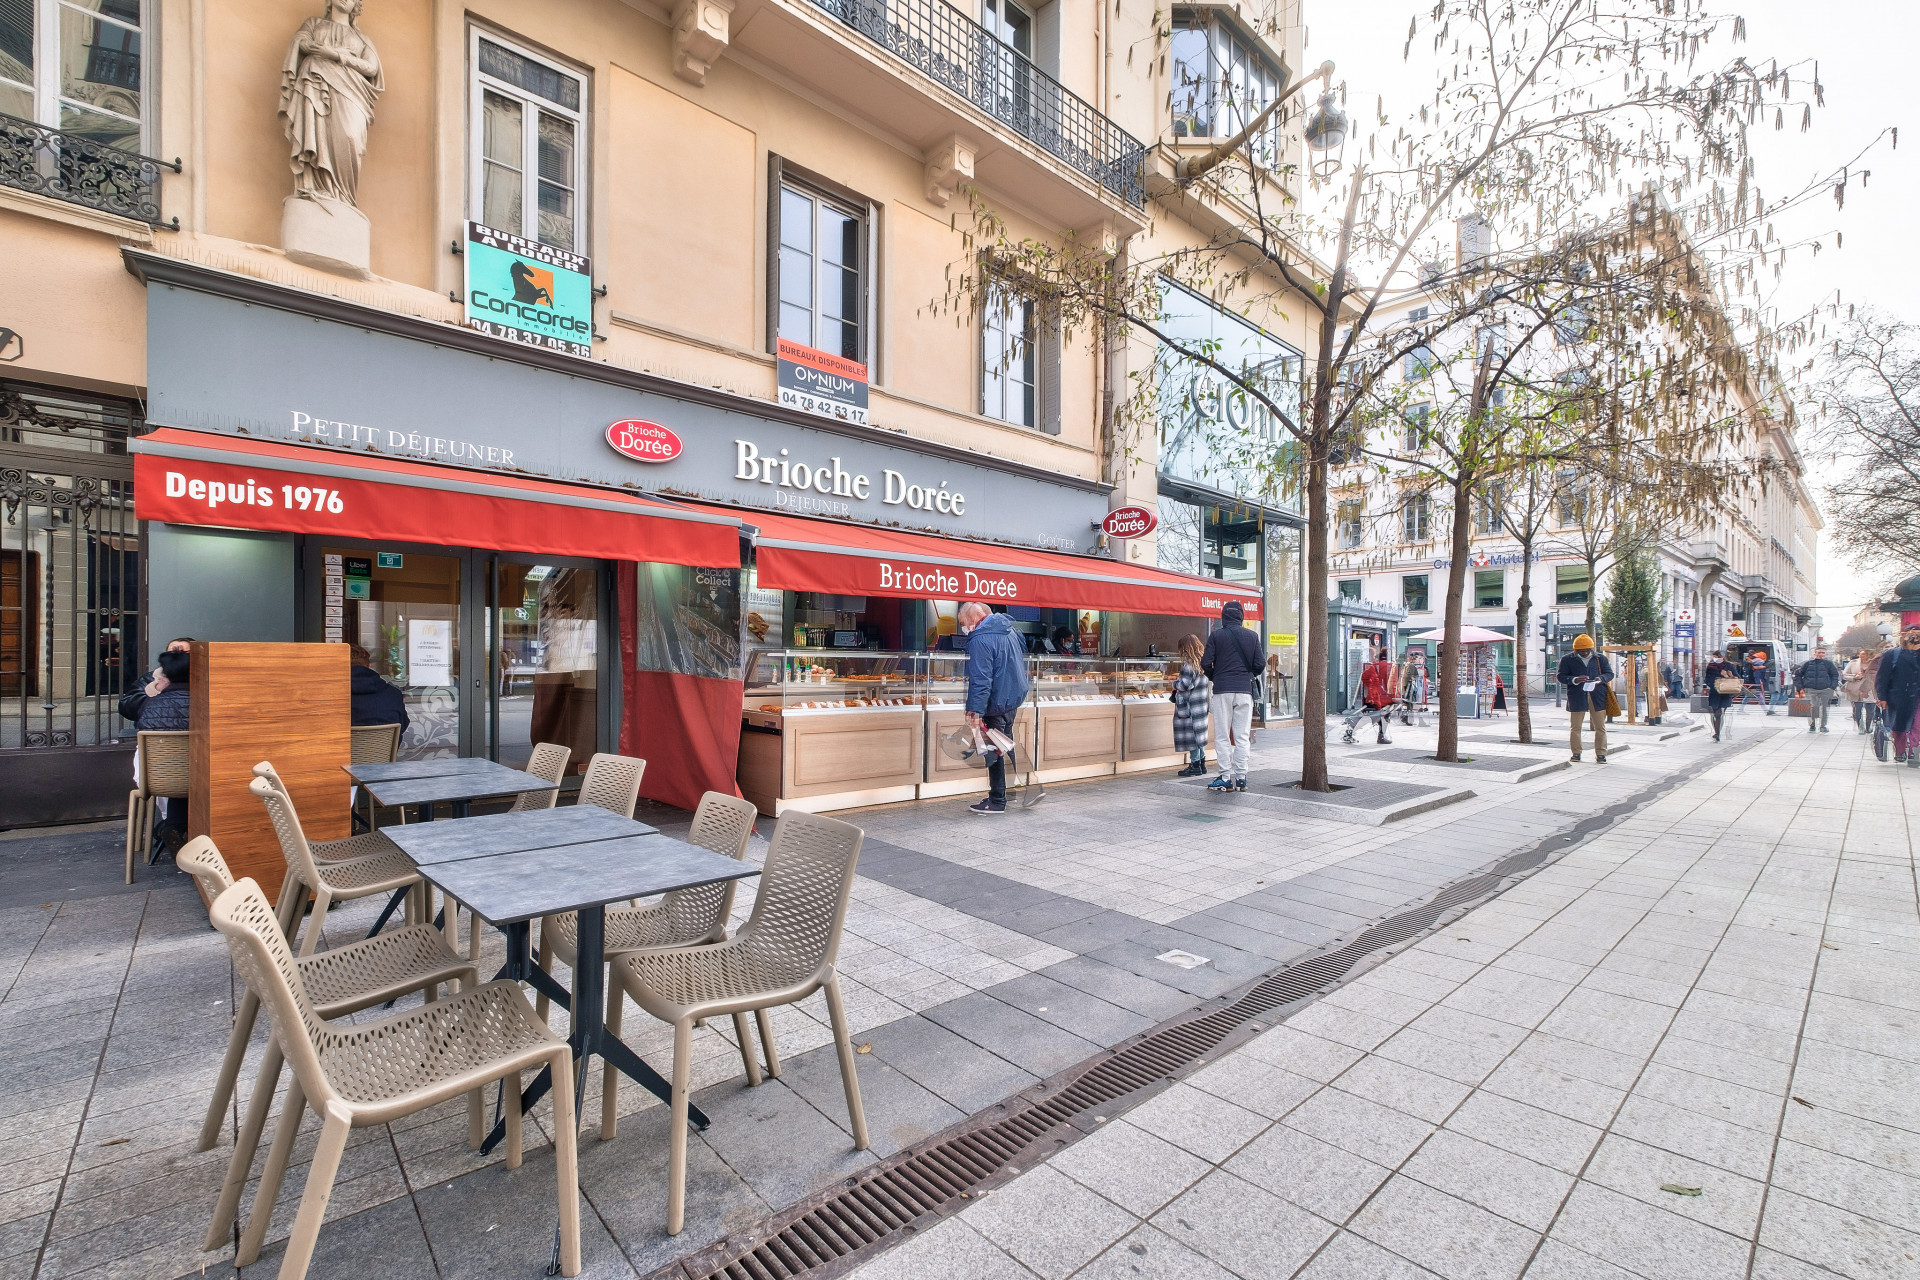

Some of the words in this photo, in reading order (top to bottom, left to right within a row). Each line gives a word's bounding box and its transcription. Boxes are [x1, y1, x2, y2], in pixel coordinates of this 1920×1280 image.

[475, 224, 585, 266] BUREAUX
[481, 235, 498, 247] A
[507, 243, 579, 272] LOUER
[471, 290, 589, 334] Concorde
[471, 319, 491, 337] 04
[498, 325, 518, 342] 78
[523, 332, 541, 346] 37
[548, 338, 566, 353] 05
[572, 344, 590, 358] 36
[780, 344, 816, 361] BUREAUX
[819, 356, 866, 377] DISPONIBLES
[795, 366, 854, 395] OMNIUM
[782, 391, 797, 405] 04
[800, 396, 814, 410] 78
[817, 401, 831, 414] 42
[834, 405, 848, 418] 53
[851, 409, 864, 422] 17
[290, 410, 380, 444] PETIT
[388, 430, 516, 466] DÉJEUNER
[620, 431, 672, 456] Dorée
[628, 422, 667, 439] Brioche
[166, 471, 274, 508] Depuis
[282, 484, 344, 514] 1976
[734, 439, 870, 500] Brioche
[882, 468, 966, 516] Dorée
[775, 489, 849, 515] DÉJEUNER
[1115, 510, 1140, 521] Brioche
[1109, 518, 1145, 534] Dorée
[349, 561, 368, 569] Uber
[695, 566, 721, 577] Click
[880, 562, 959, 593] Brioche
[964, 571, 1017, 598] Dorée
[695, 575, 731, 587] Collect
